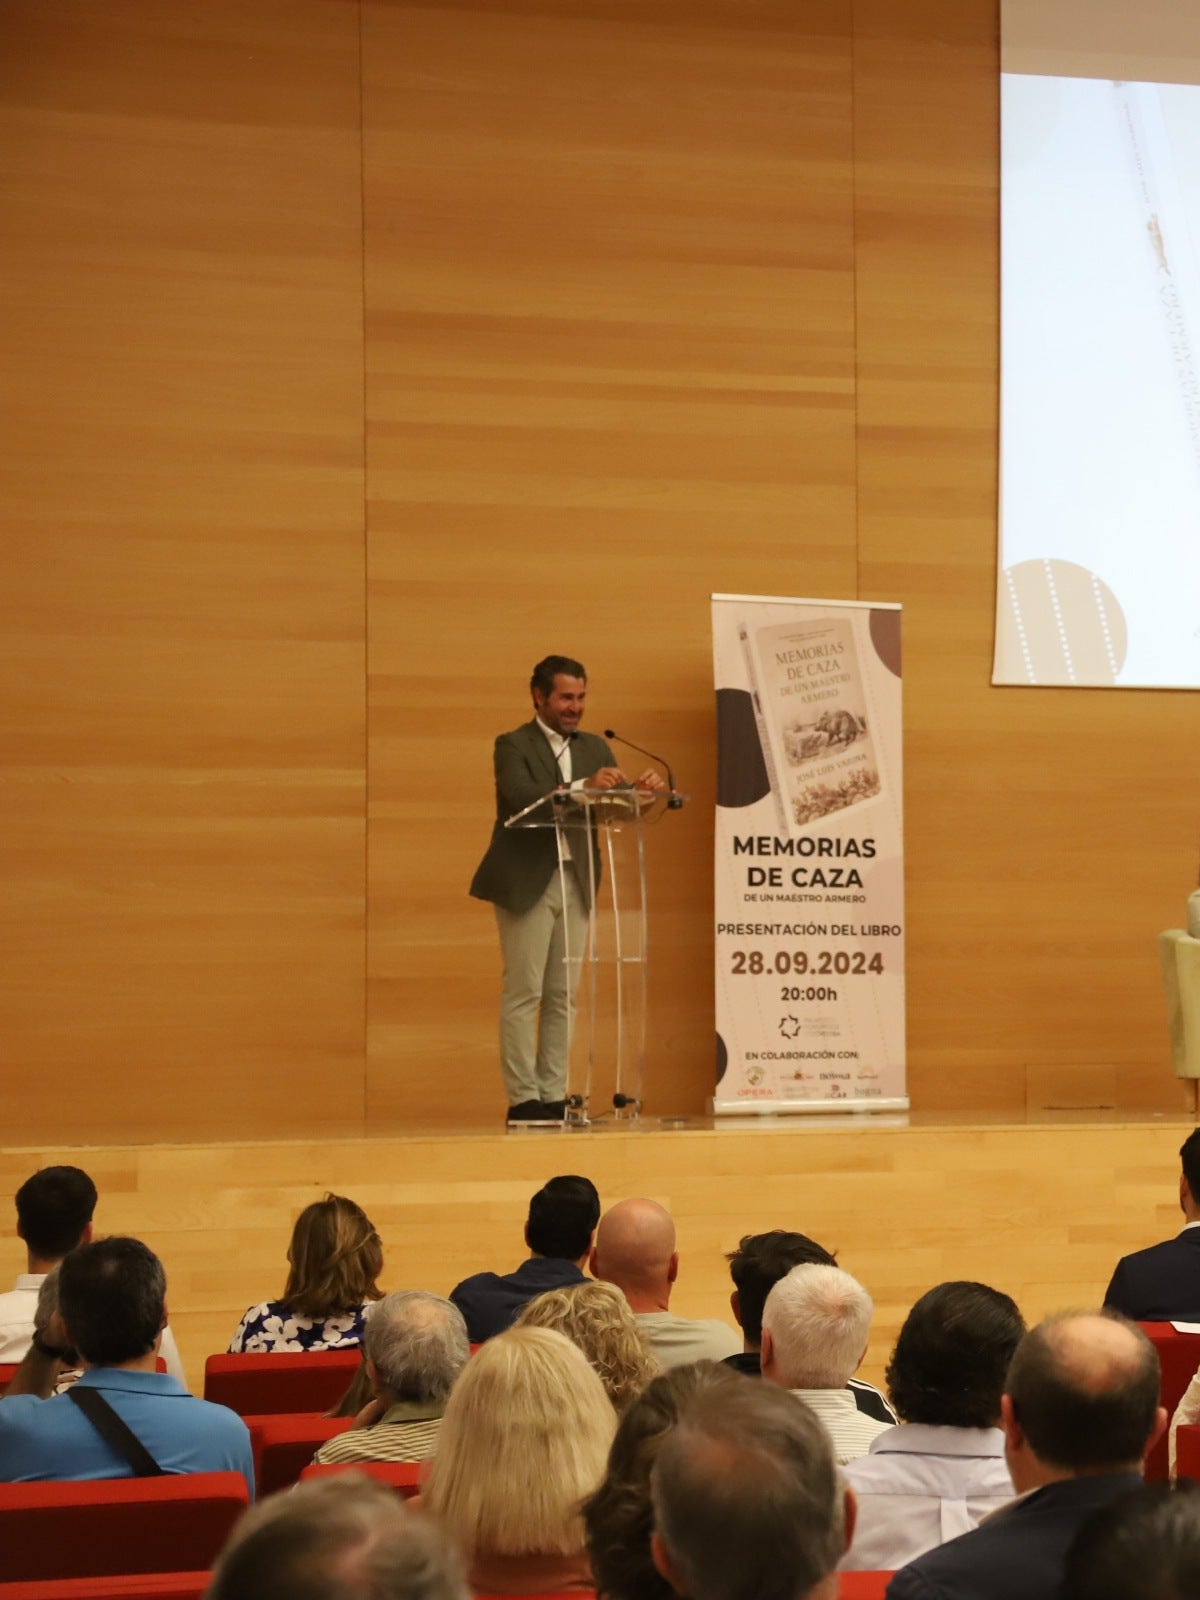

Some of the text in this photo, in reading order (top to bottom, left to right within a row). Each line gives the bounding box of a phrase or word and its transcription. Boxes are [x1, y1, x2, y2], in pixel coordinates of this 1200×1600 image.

[775, 641, 845, 666] MEMORIAS
[787, 659, 841, 680] DE CAZA
[733, 836, 876, 858] MEMORIAS
[747, 867, 864, 888] DE CAZA
[744, 894, 866, 903] DE UN MAESTRO ARMERO
[717, 921, 902, 937] PRESENTACIÓN DEL LIBRO
[731, 951, 884, 975] 28.09.2024
[780, 986, 837, 1001] 20:00h
